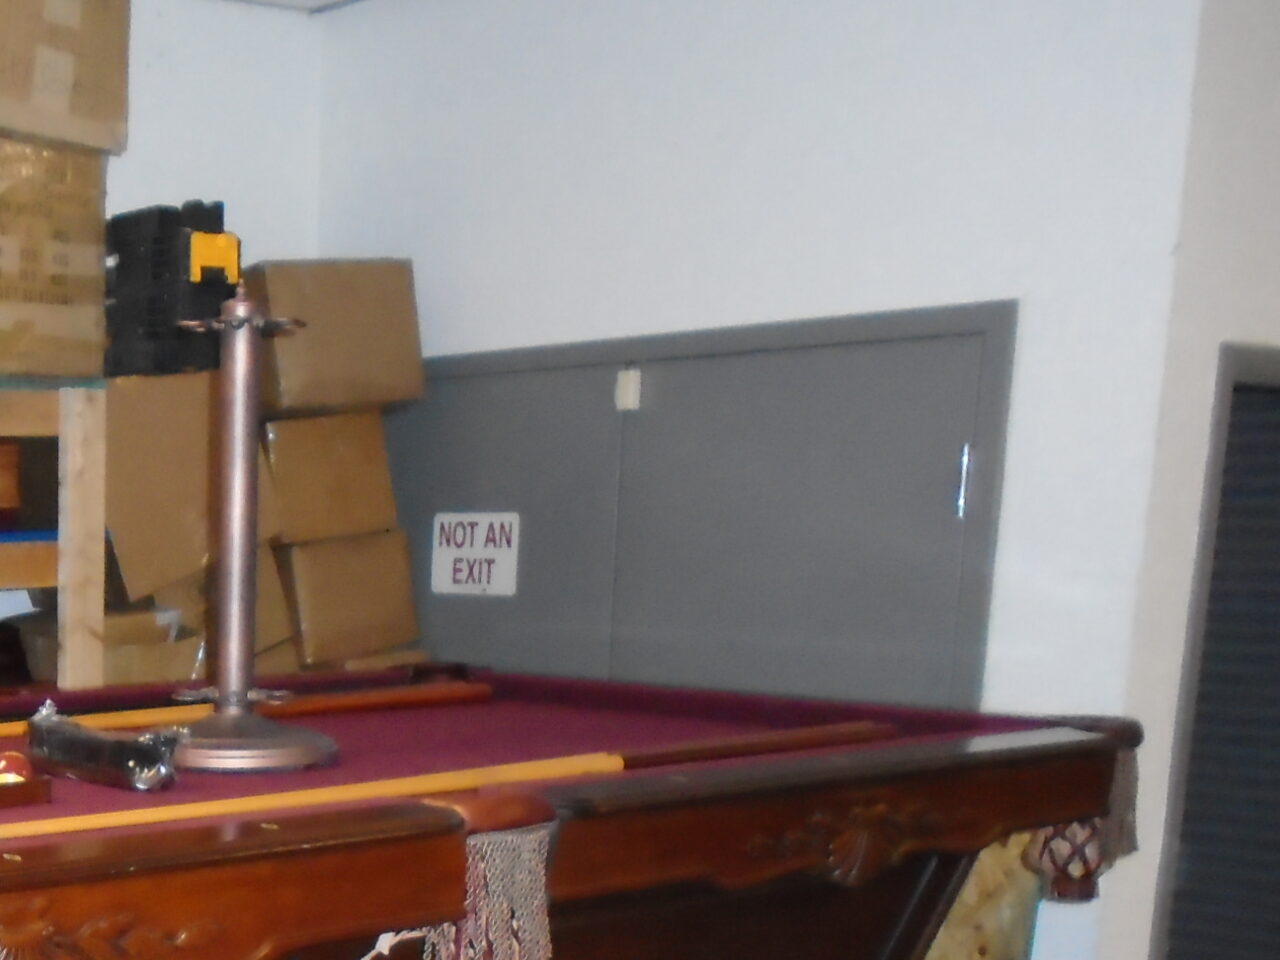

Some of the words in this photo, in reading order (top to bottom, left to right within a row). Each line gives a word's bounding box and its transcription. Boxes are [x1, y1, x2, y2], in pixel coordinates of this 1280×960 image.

[439, 520, 479, 549] NOT
[483, 520, 513, 549] AN
[451, 556, 496, 585] EXIT
